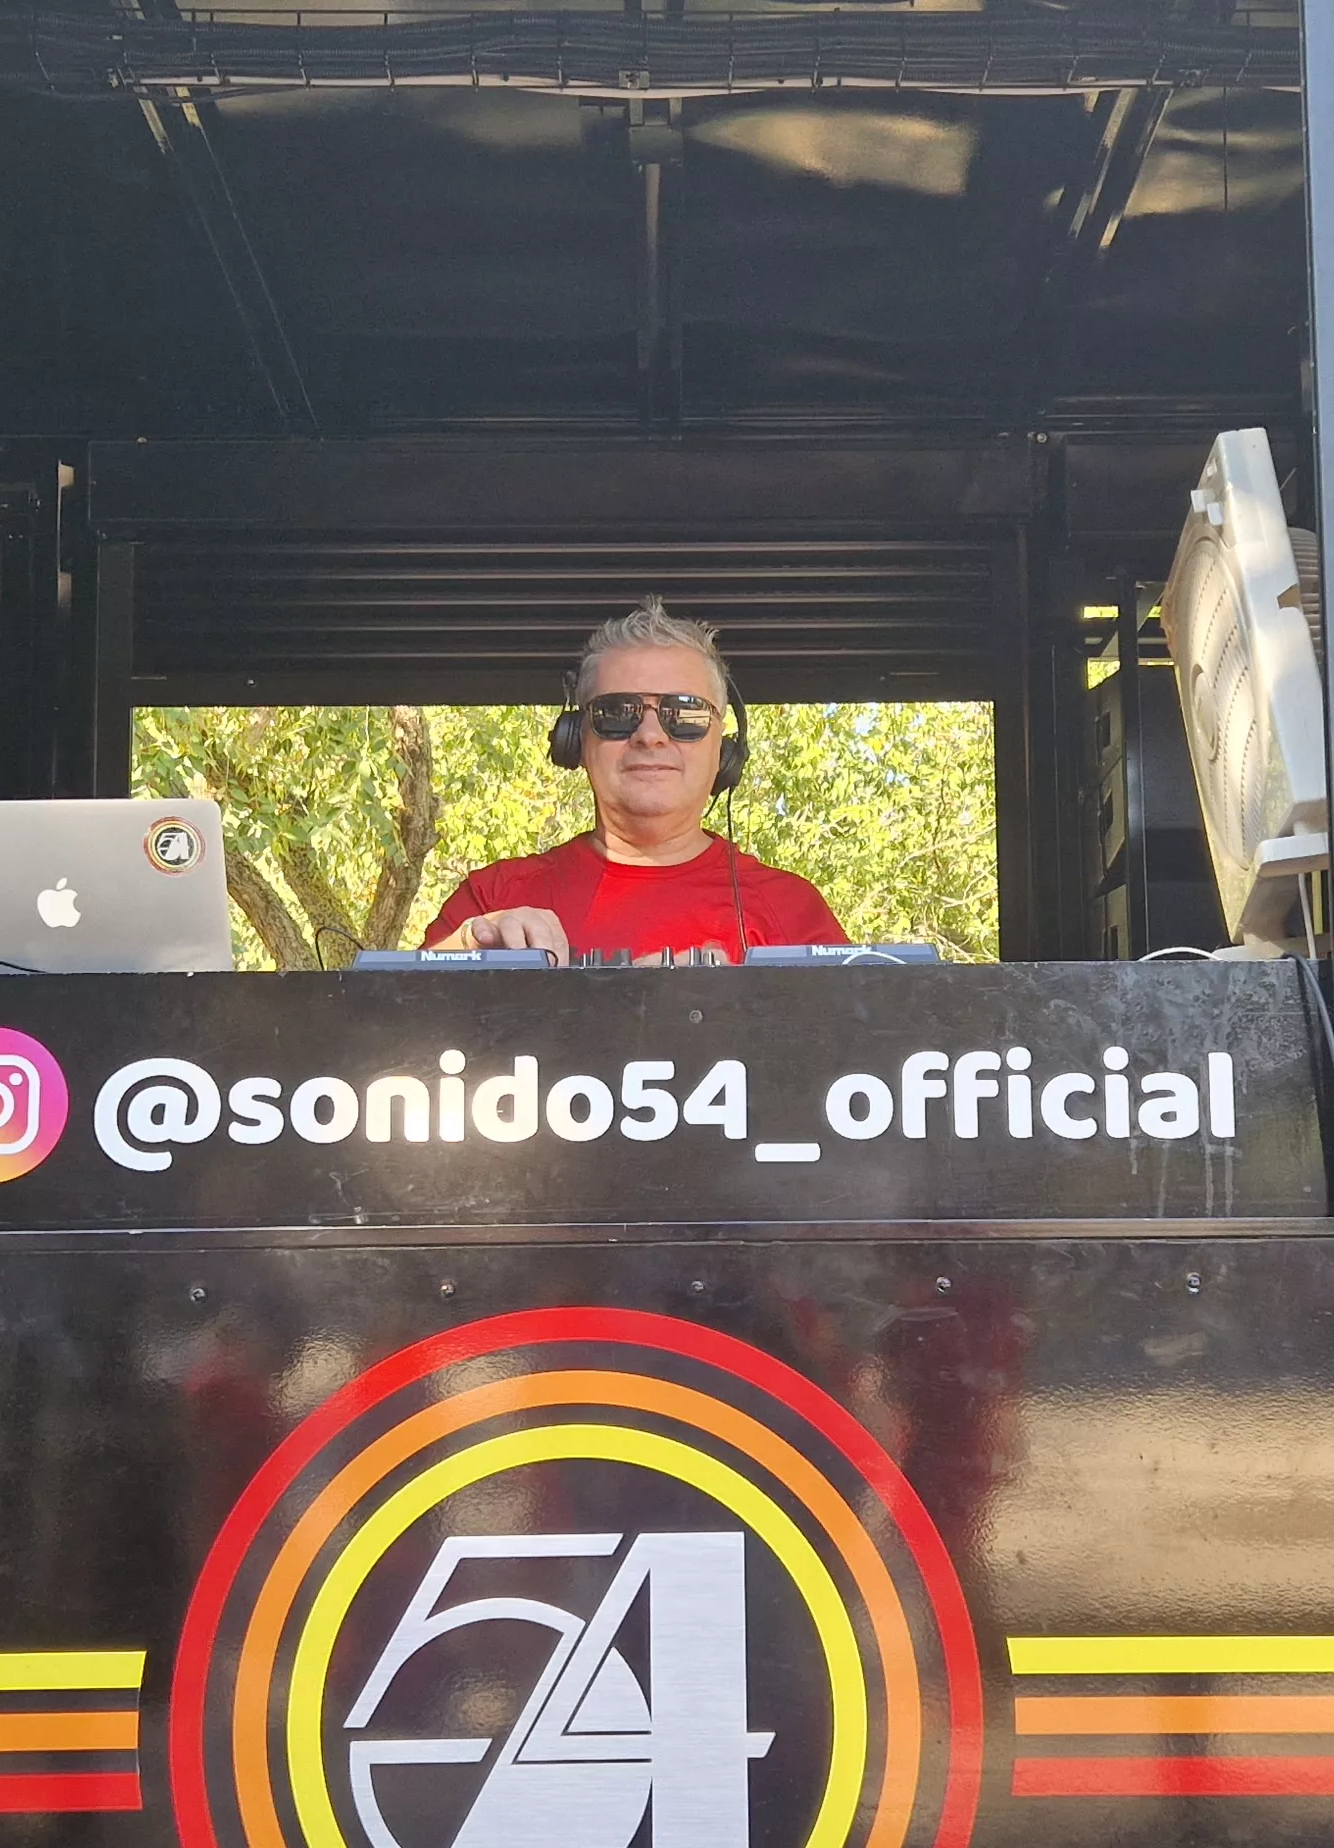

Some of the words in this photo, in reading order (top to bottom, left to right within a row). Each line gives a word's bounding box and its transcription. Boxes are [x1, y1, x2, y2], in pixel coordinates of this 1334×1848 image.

[421, 950, 482, 961] Numark
[811, 944, 872, 956] Numark
[93, 1048, 1235, 1172] @sonido54_official
[344, 1531, 776, 1848] 54
